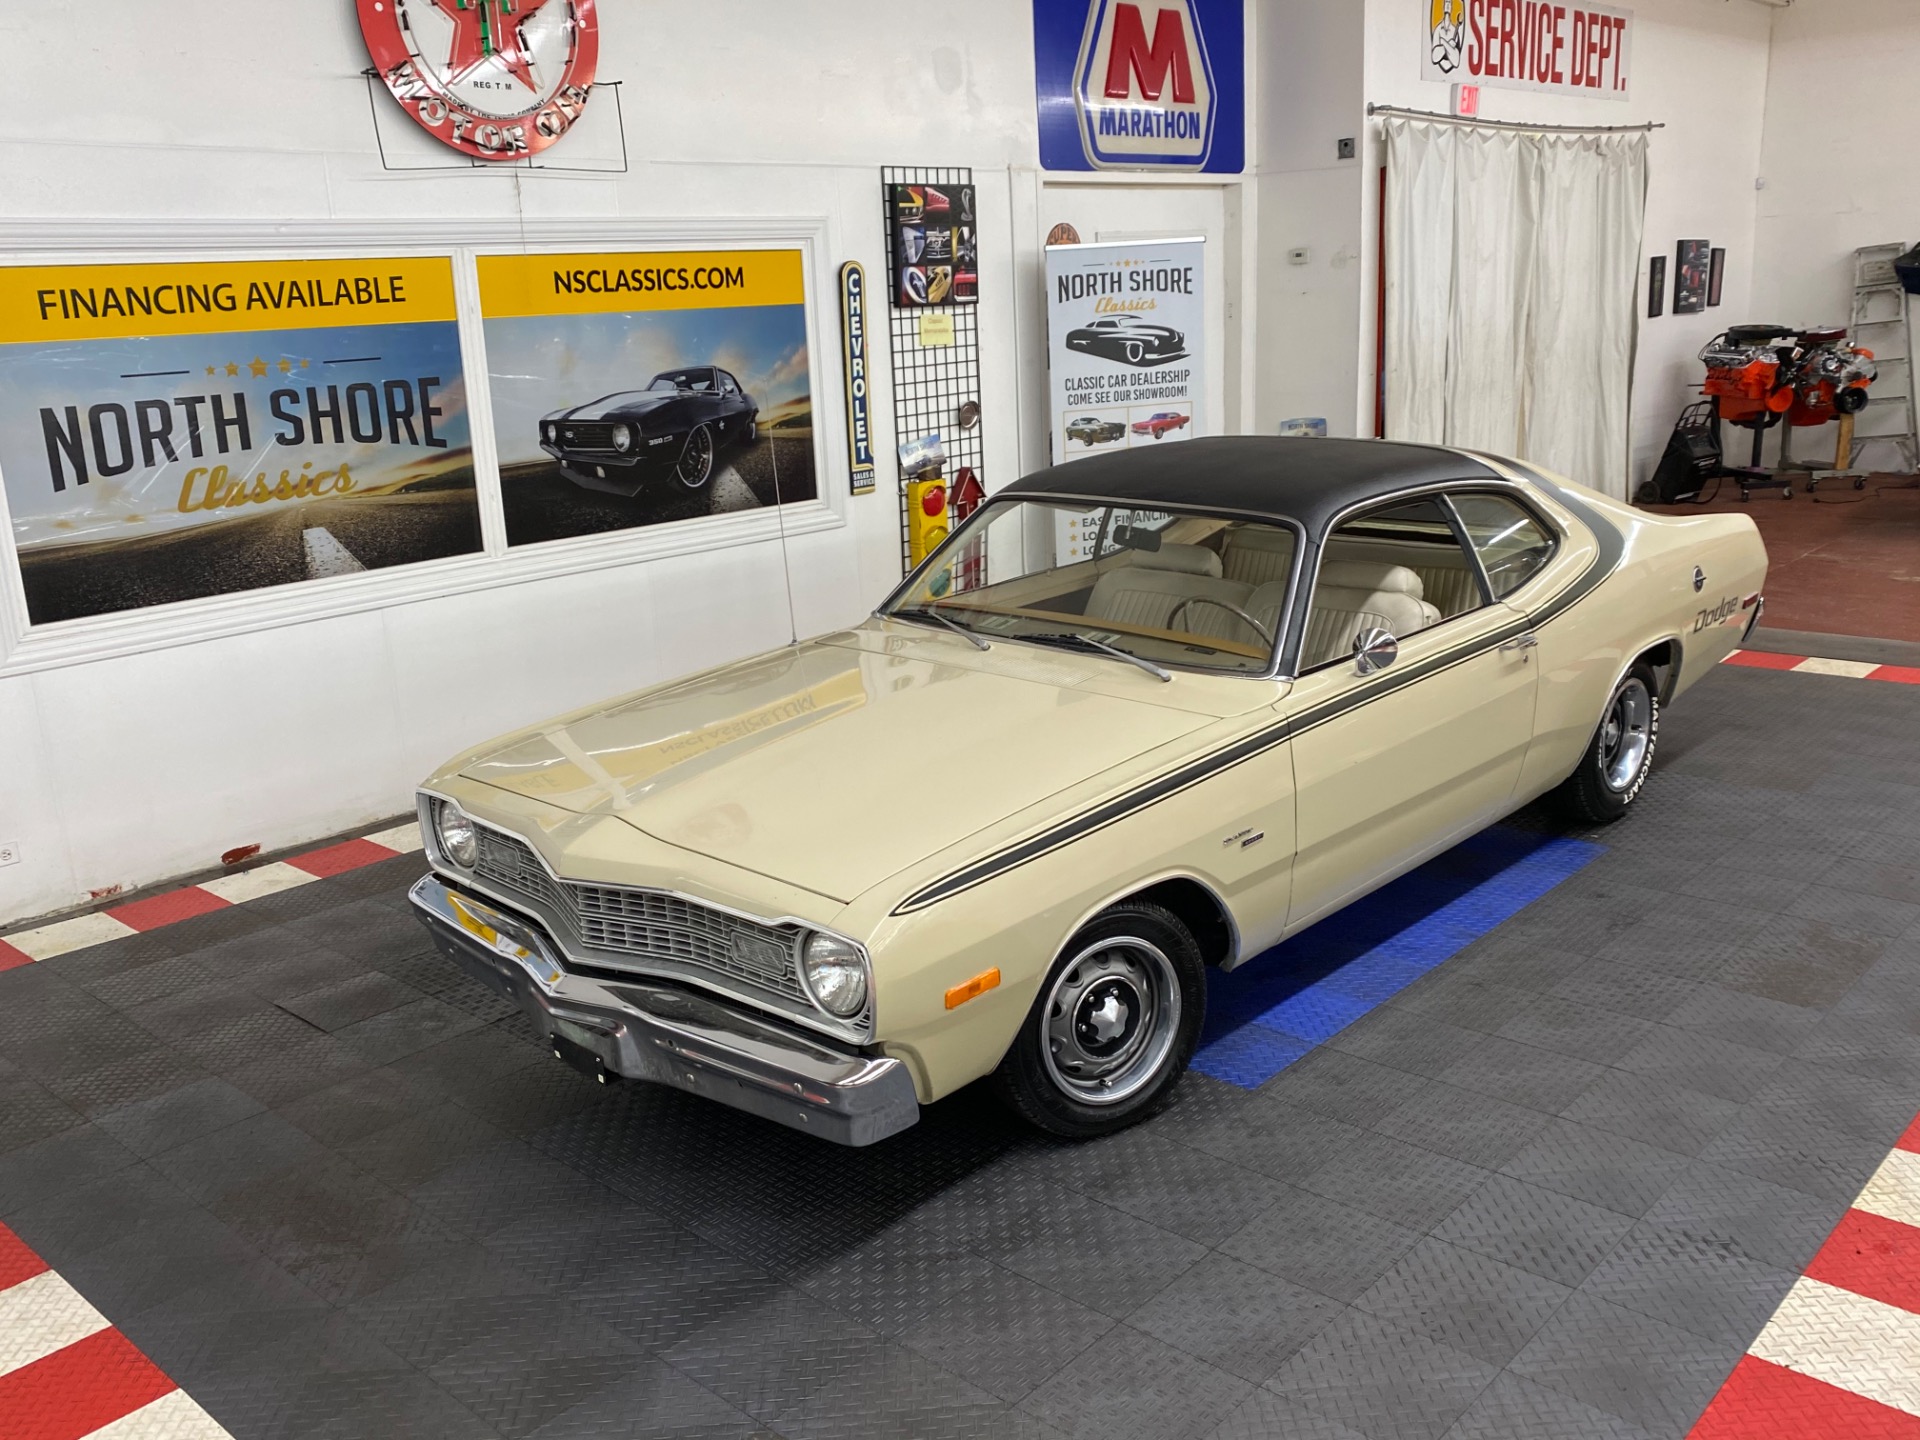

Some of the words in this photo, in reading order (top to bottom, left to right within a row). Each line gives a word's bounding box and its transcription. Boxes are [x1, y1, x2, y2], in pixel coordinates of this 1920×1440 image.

[1104, 2, 1195, 104] M
[1467, 0, 1566, 84] SERVICE
[1570, 10, 1627, 91] DEPT.
[384, 60, 529, 156] MOTOR
[1099, 107, 1200, 139] MARATHON
[37, 281, 237, 320] FINANCING
[245, 276, 406, 311] AVAILABLE
[553, 266, 744, 294] NSCLASSICS.COM
[1058, 271, 1122, 304] NORTH
[1129, 267, 1193, 295] SHORE
[1095, 296, 1157, 314] Classics
[849, 273, 868, 460] CHEVROLET
[1064, 375, 1105, 391] CLASSIC
[1107, 373, 1127, 388] CAR
[1130, 369, 1190, 386] DEALERSHIP
[1067, 392, 1093, 406] COME
[1095, 391, 1111, 403] SEE
[1113, 389, 1132, 402] OUR
[1133, 385, 1188, 401] SHOWROOM!
[40, 391, 252, 493] NORTH
[269, 376, 448, 449] SHORE
[177, 460, 360, 515] Classics
[1082, 516, 1103, 528] EAS
[1693, 596, 1739, 634] Dodge
[1623, 696, 1659, 805] MASTERCRAFT
